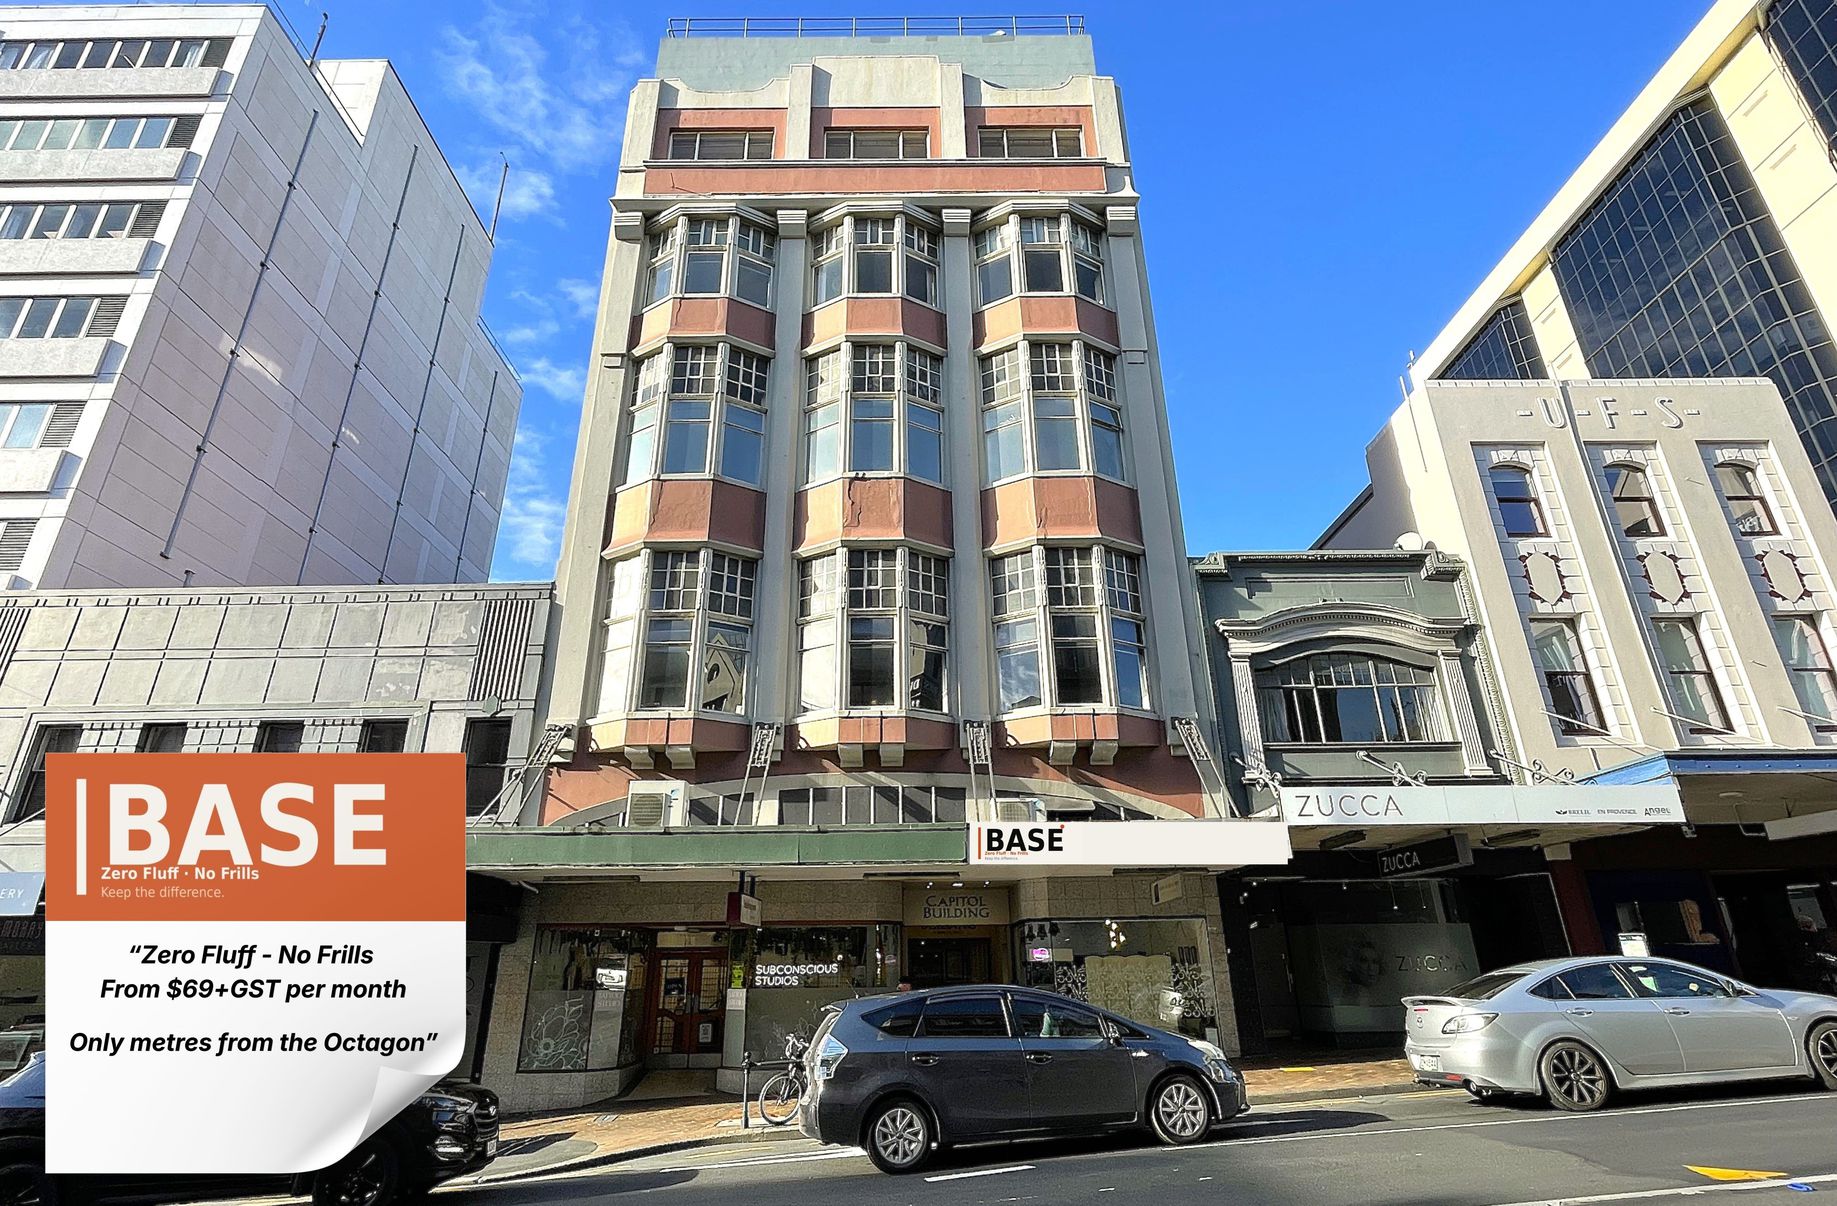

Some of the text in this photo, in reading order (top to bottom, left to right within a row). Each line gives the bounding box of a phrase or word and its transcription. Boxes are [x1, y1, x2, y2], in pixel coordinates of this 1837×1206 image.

[1295, 795, 1403, 816] ZUCCA
[987, 828, 1063, 851] BASE
[1381, 852, 1421, 872] ZUCCA
[926, 896, 986, 907] CAPITOL
[924, 907, 989, 918] BUILDING
[756, 964, 838, 975] SUBCONSCIOUS
[755, 976, 799, 986] STUDIOS
